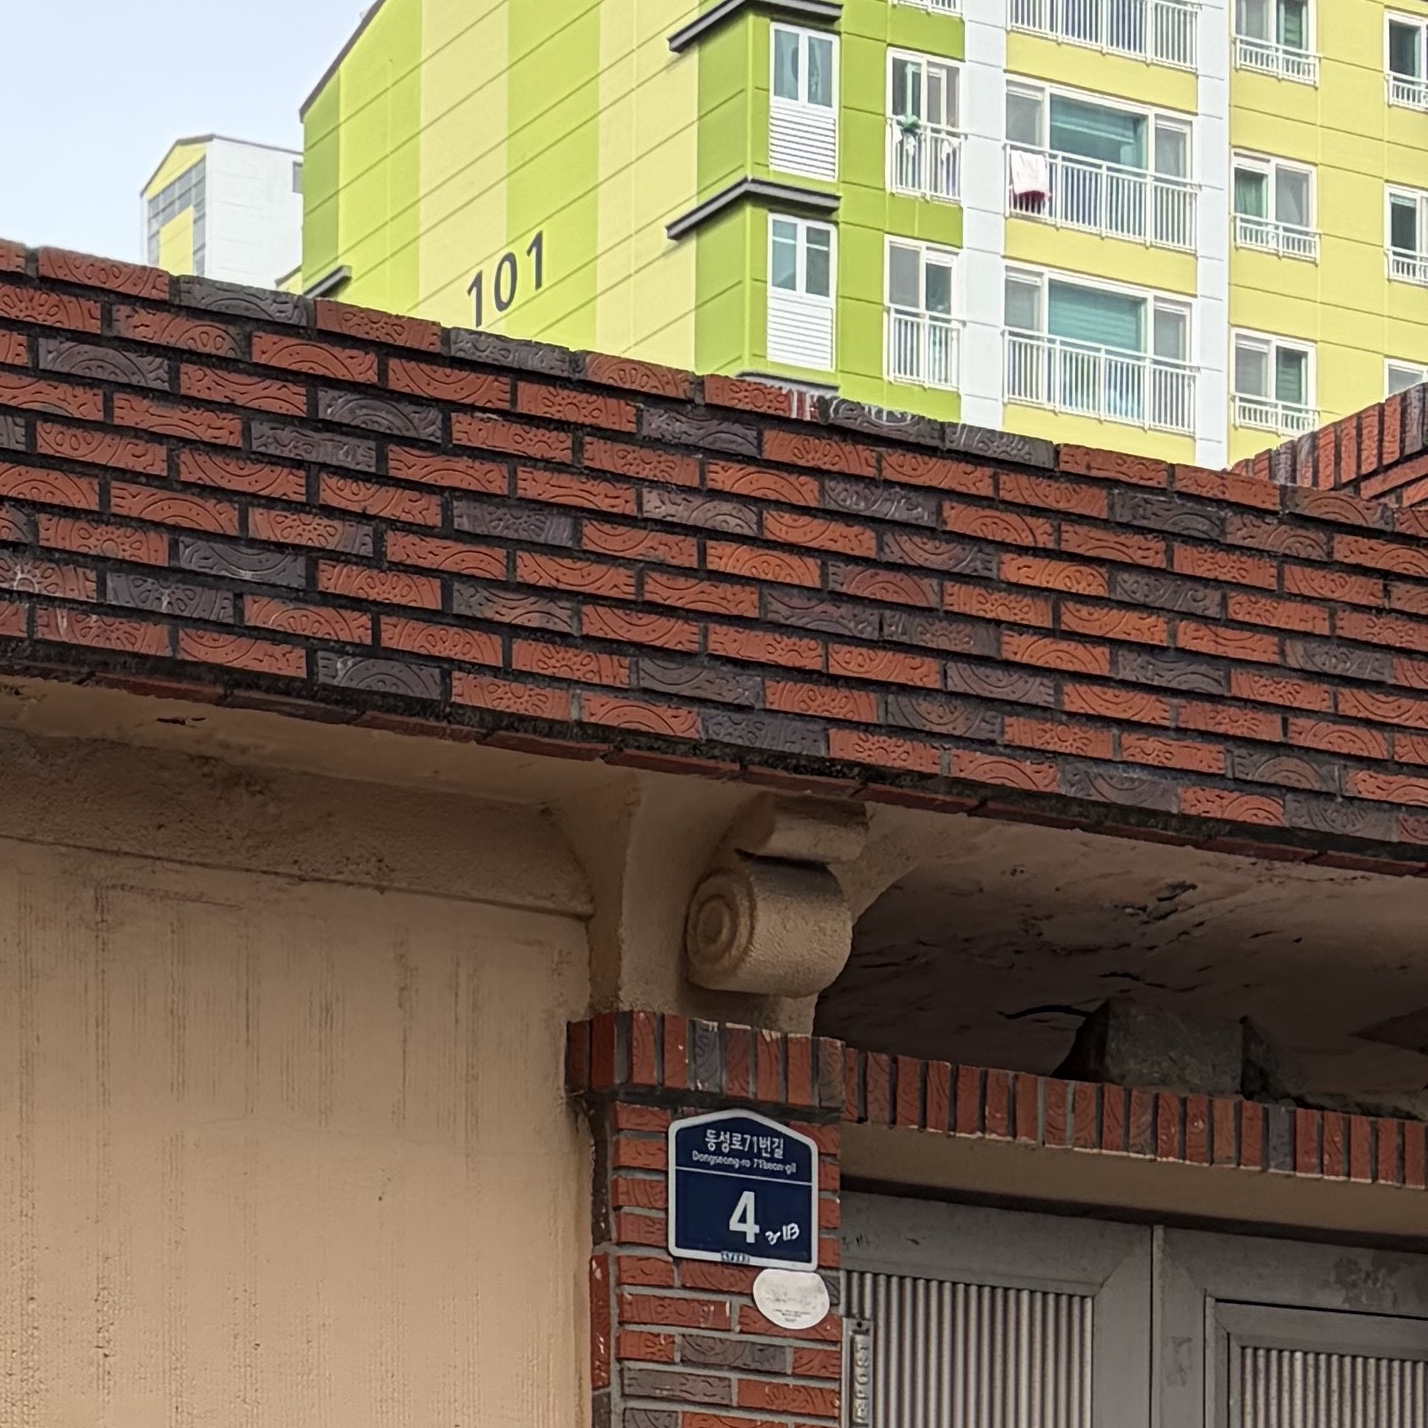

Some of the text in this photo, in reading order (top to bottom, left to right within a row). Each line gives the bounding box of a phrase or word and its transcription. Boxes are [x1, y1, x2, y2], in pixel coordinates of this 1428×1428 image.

[466, 229, 544, 328] 101
[704, 1128, 784, 1160] 동성로71번길
[728, 1190, 760, 1244] 4
